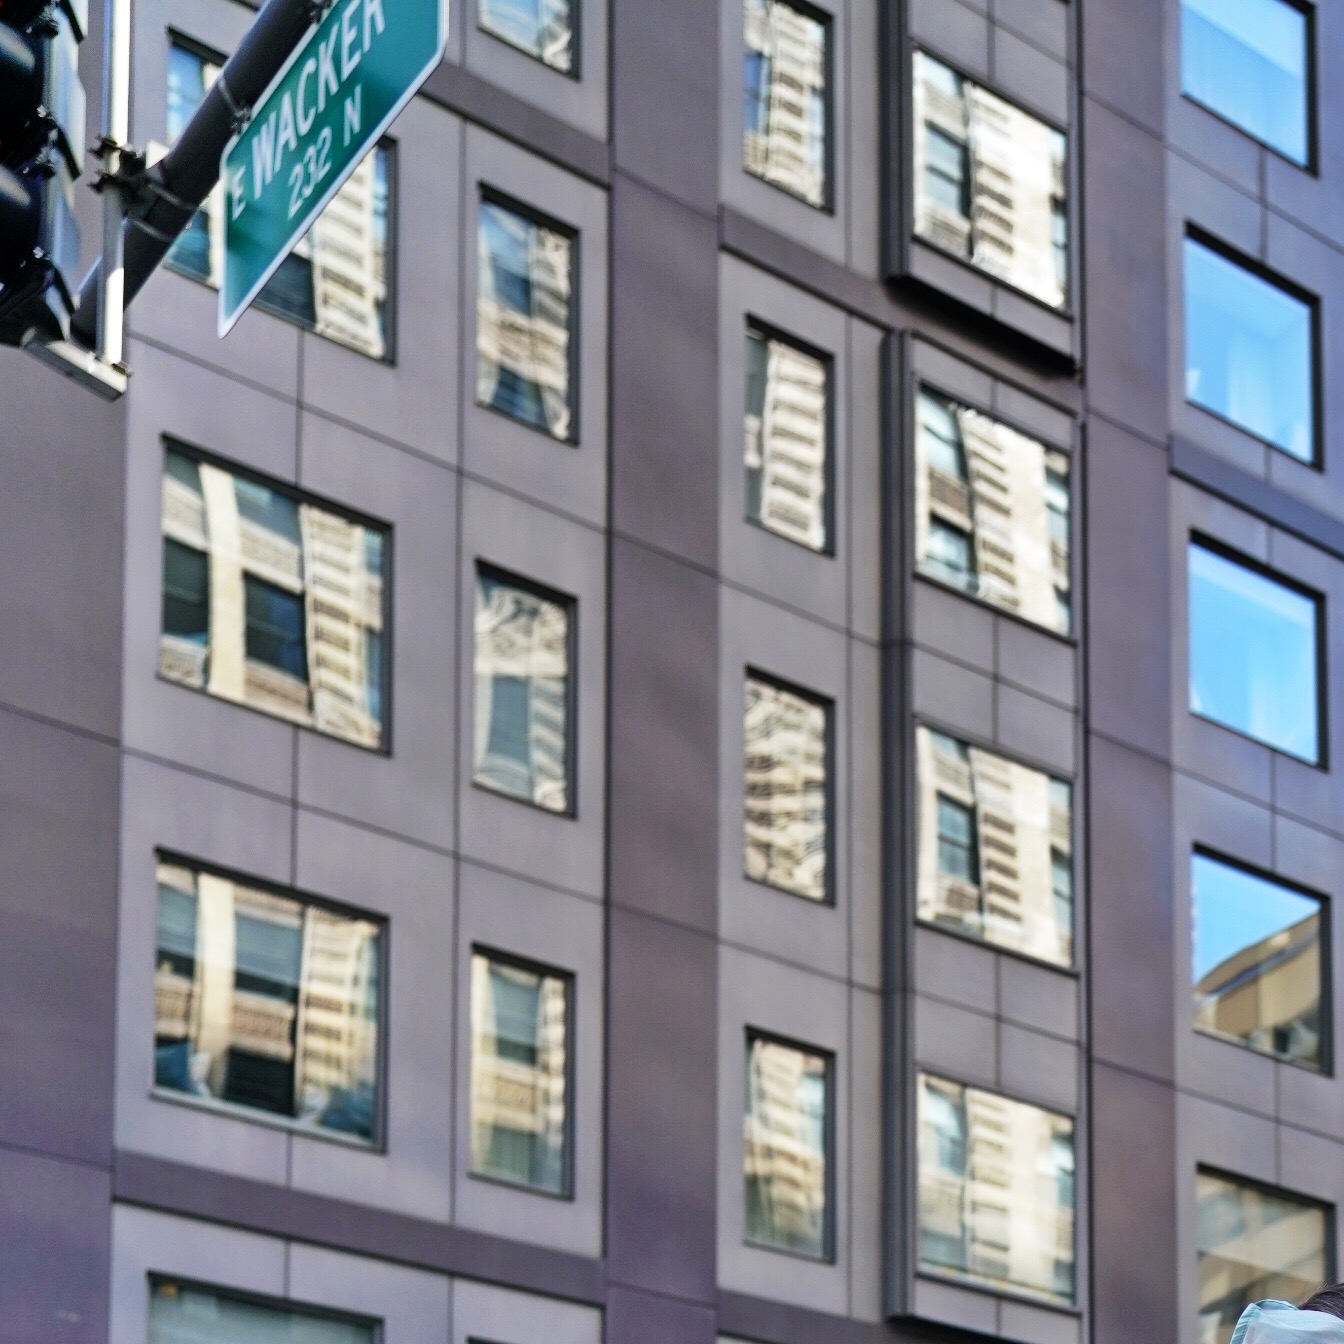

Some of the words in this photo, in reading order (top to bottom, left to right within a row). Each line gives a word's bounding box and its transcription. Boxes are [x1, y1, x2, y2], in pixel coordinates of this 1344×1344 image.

[231, 165, 247, 221] E
[251, 0, 386, 200] WACKER
[287, 125, 332, 220] 232
[343, 82, 362, 147] N
